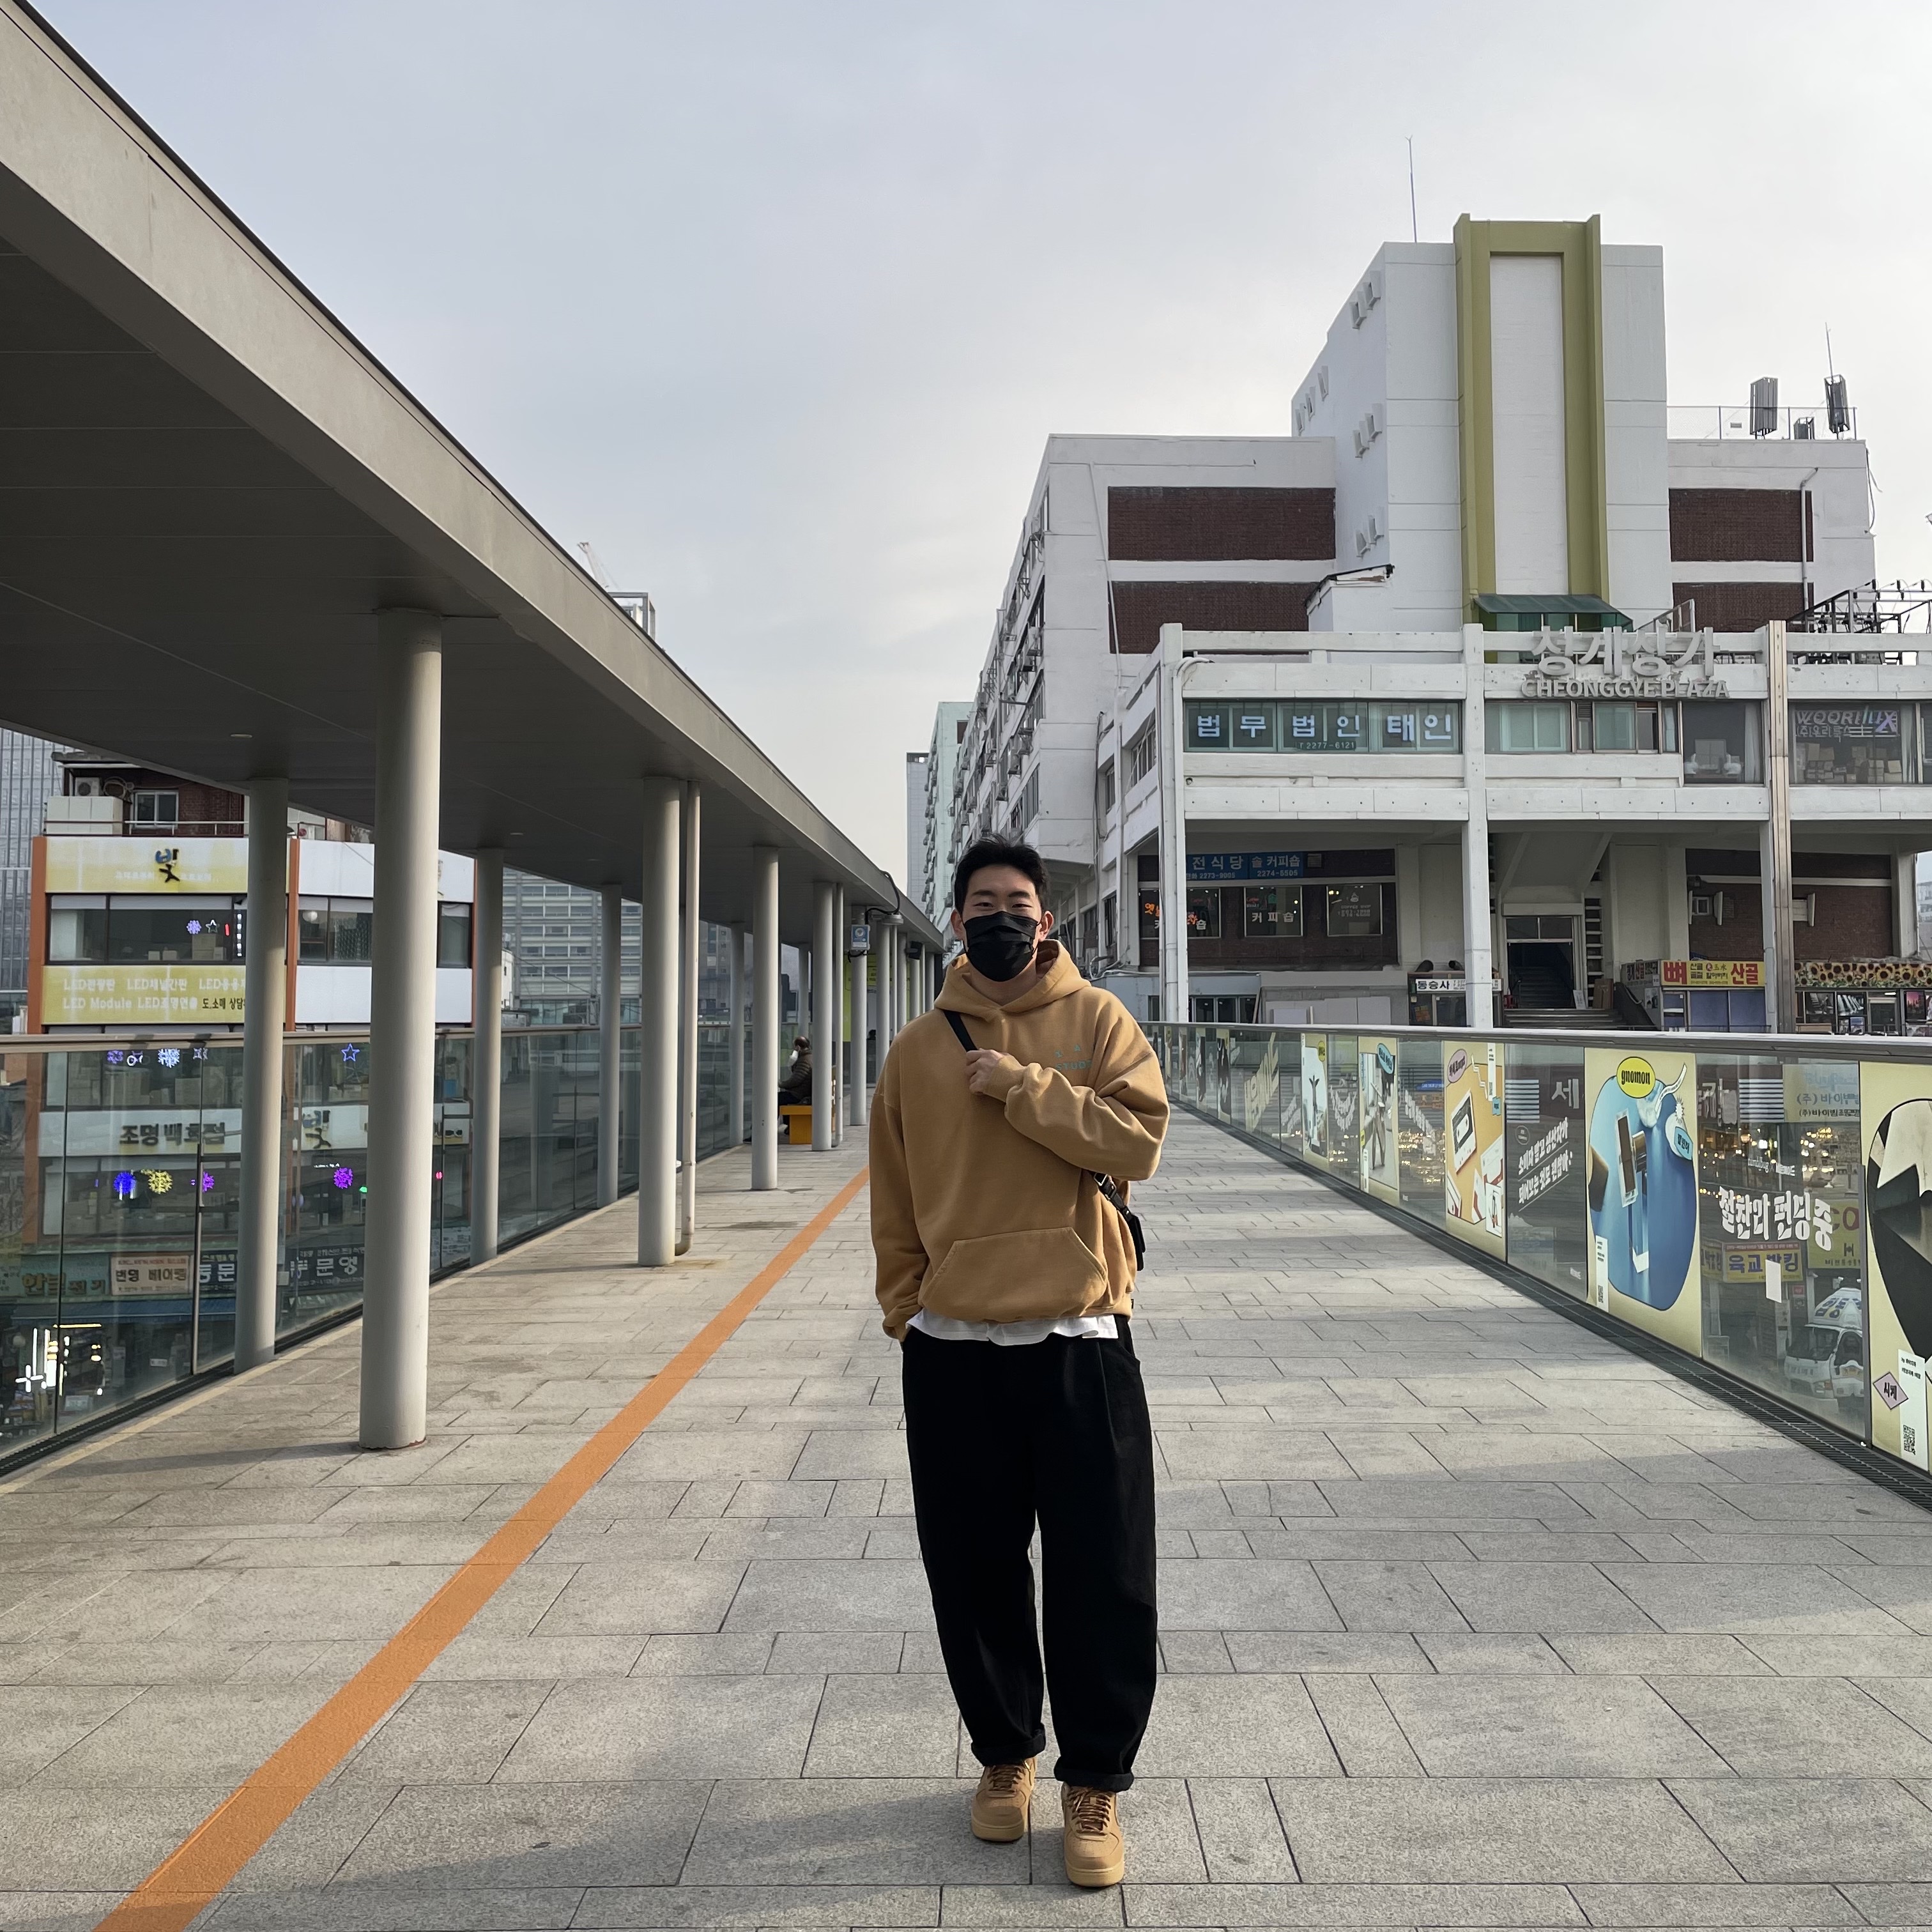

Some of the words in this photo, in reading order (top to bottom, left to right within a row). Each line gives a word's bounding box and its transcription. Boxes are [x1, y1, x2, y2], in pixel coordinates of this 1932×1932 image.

[1531, 625, 1720, 676] 청계상가
[1521, 679, 1656, 698] CHEONGGYE
[1660, 679, 1729, 698] PLAZA
[1386, 714, 1452, 741] 태인
[1306, 742, 1355, 750] 2277-6121
[155, 848, 180, 883] 빛
[1266, 854, 1301, 868] 커피숍
[1251, 911, 1294, 923] 커피숍
[1731, 963, 1759, 985] 산골
[1417, 980, 1450, 990] 동승사
[63, 997, 86, 1009] LED
[90, 997, 132, 1010] Module
[229, 997, 245, 1010] 상담
[1621, 1070, 1651, 1085] gnomon
[1883, 1381, 1898, 1402] 시계
